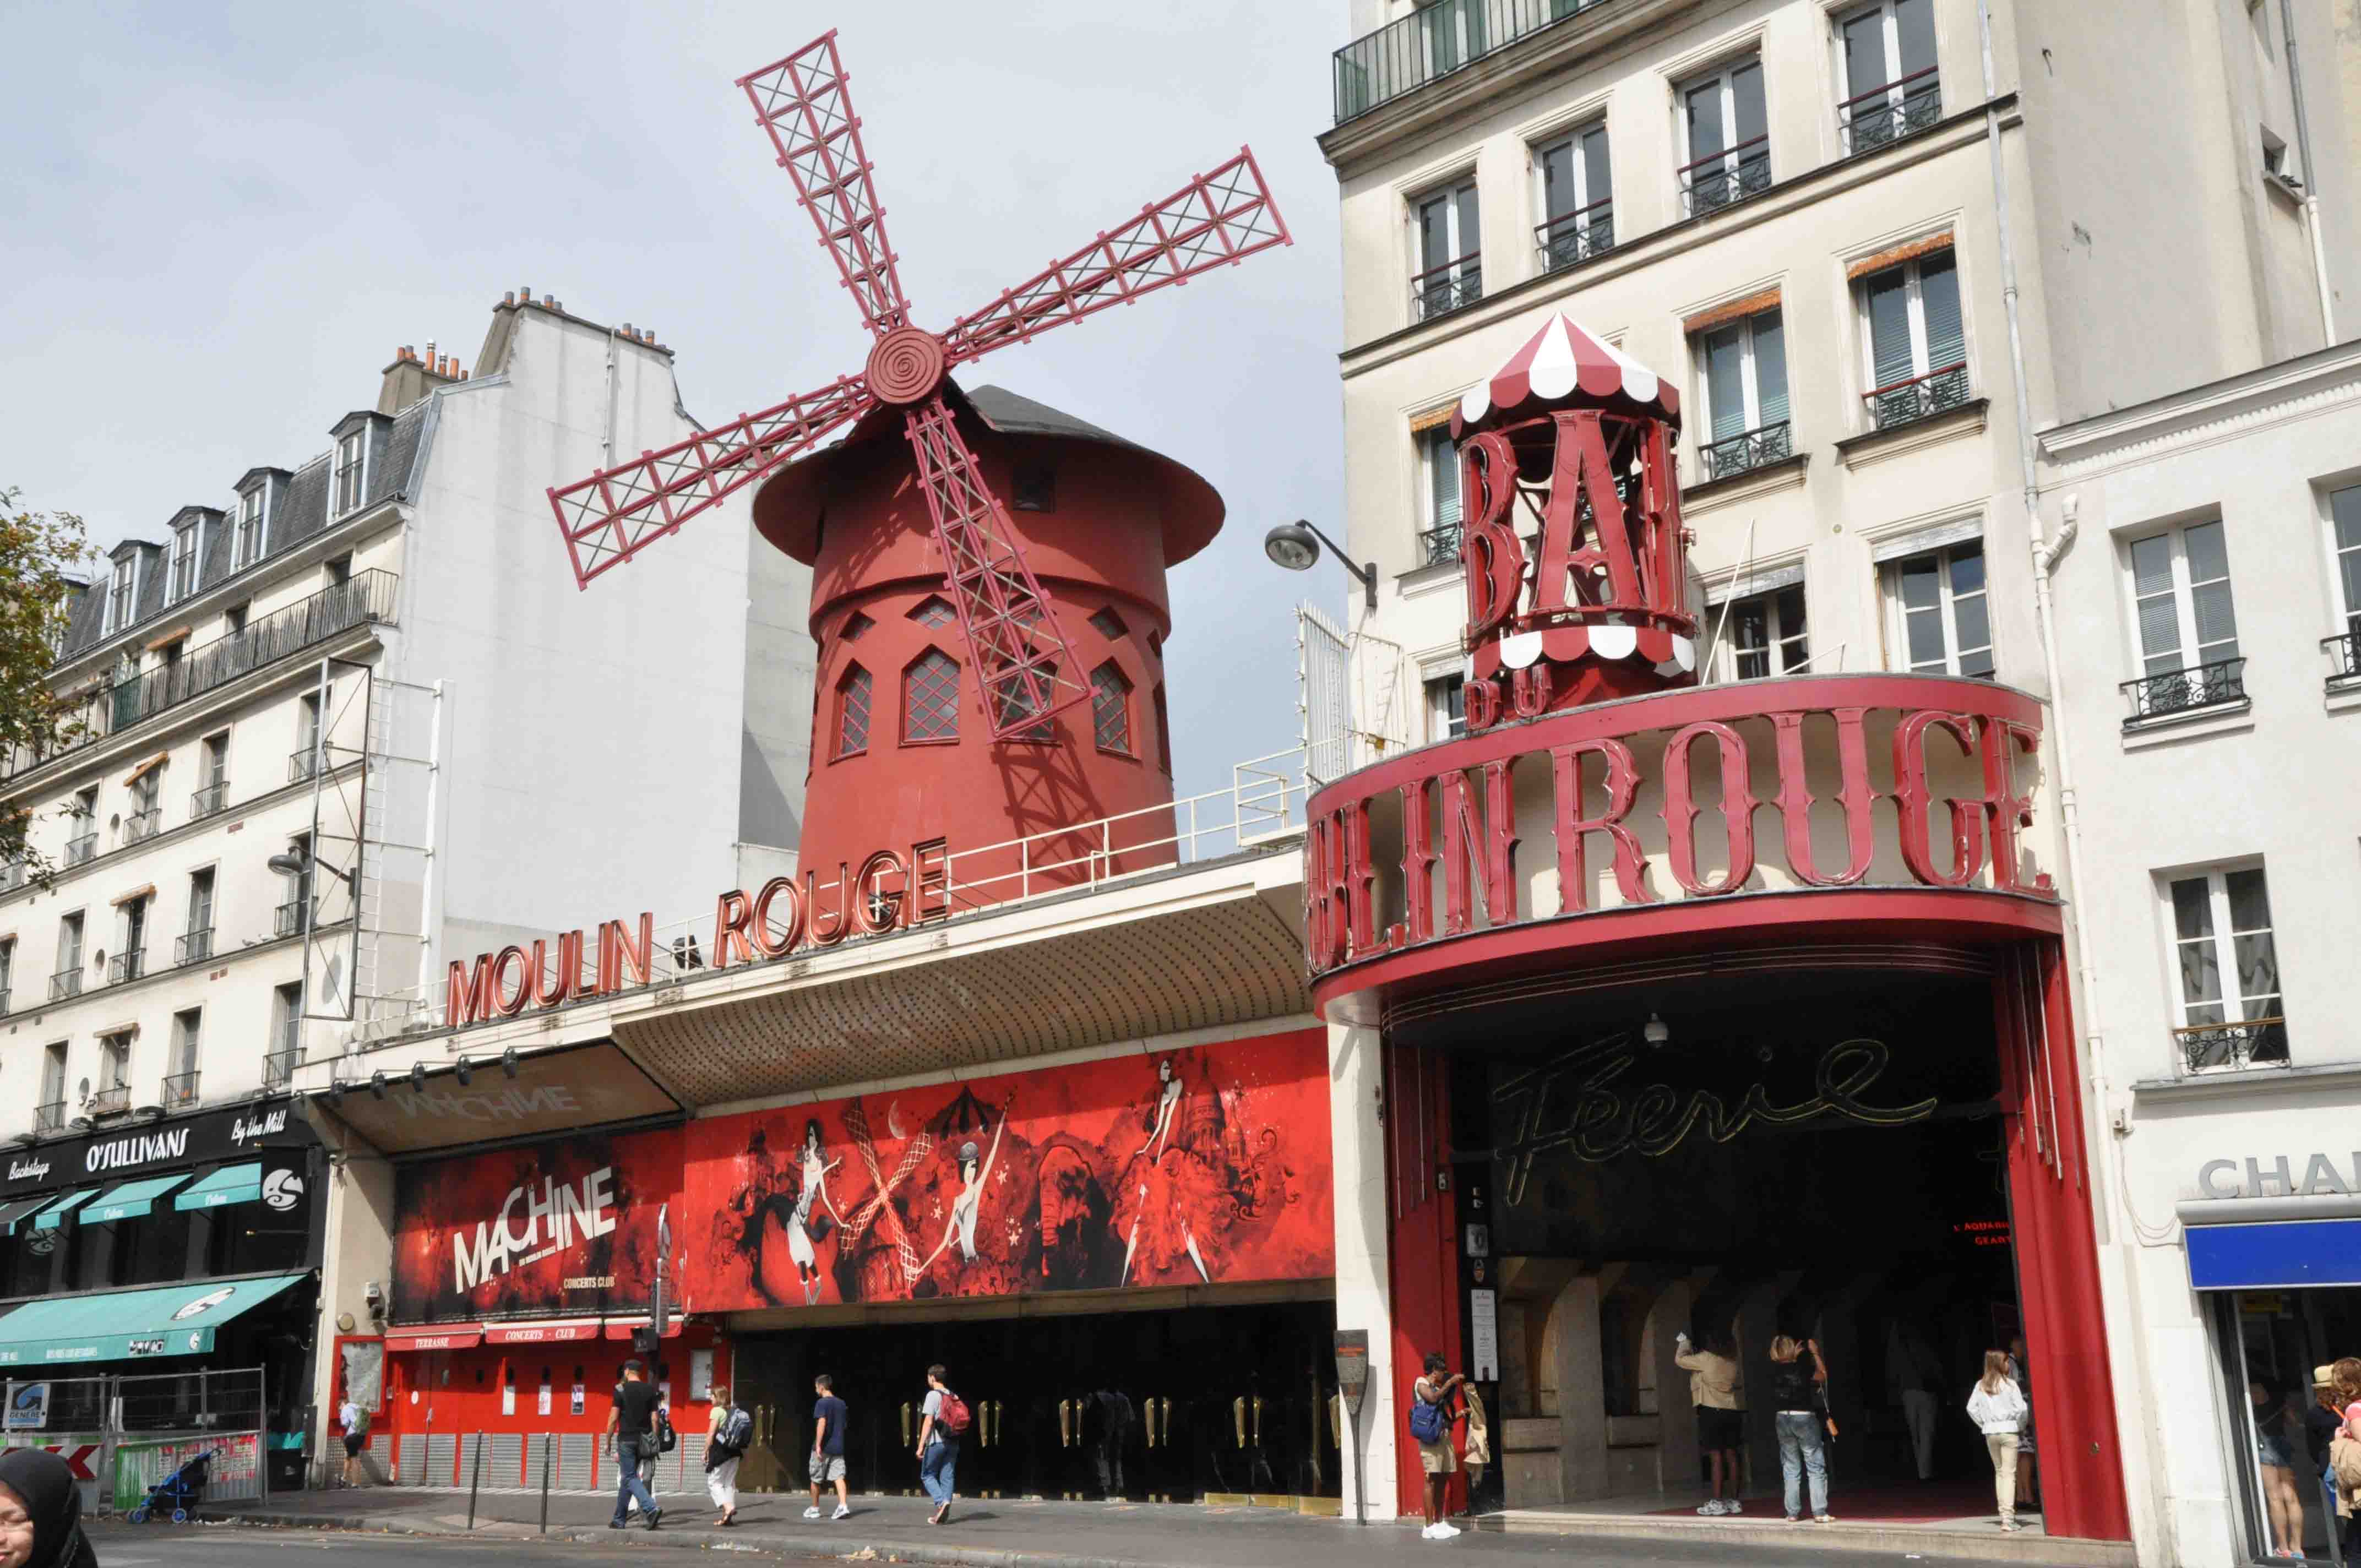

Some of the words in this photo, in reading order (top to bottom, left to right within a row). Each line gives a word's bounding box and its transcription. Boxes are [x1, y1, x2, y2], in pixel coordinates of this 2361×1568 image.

[1462, 664, 1553, 729] DU
[1551, 707, 2059, 913] ROUGE
[446, 912, 653, 1027] MOULIN
[712, 836, 950, 968] ROUGE
[8, 1157, 50, 1182] Backstage
[86, 1128, 189, 1172] O'SULLIVANS
[231, 1118, 246, 1147] By
[246, 1115, 263, 1138] the
[262, 1109, 286, 1134] Mill
[2198, 1151, 2361, 1199] CHA
[454, 1167, 616, 1294] MACHINE
[563, 1277, 596, 1289] CONCERTS
[598, 1276, 615, 1287] CLUB
[415, 1337, 449, 1349] TERRASSE
[505, 1330, 544, 1341] CONCERTS
[555, 1328, 575, 1339] CLUB
